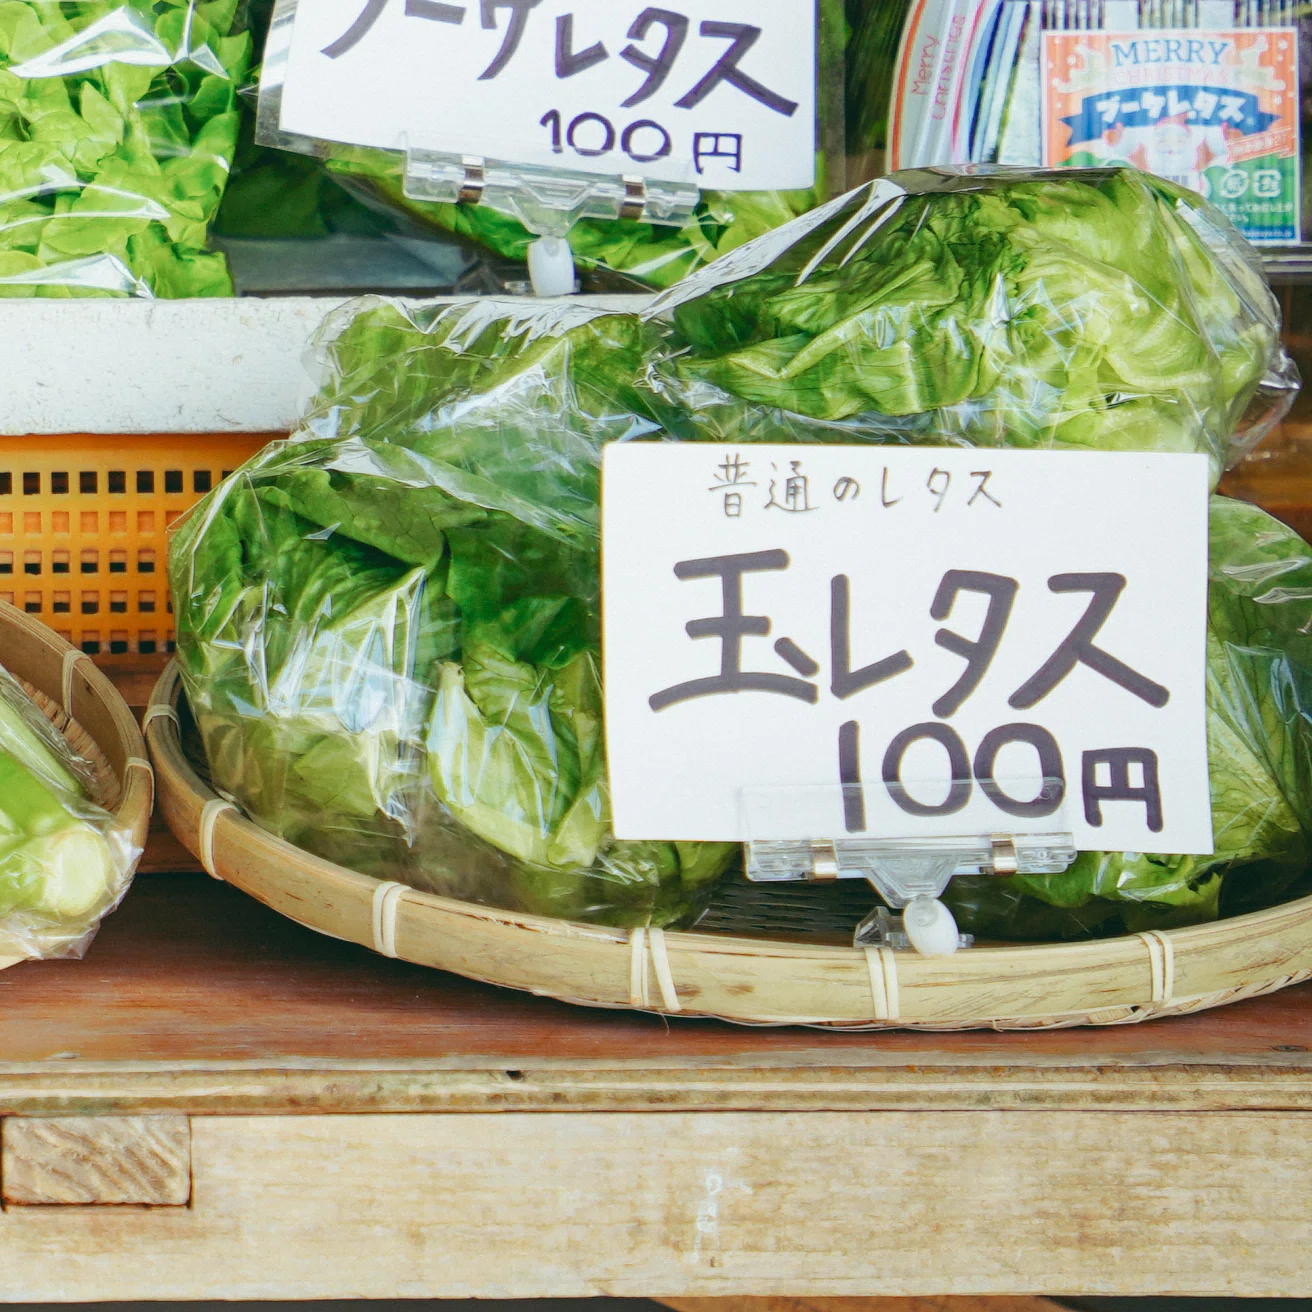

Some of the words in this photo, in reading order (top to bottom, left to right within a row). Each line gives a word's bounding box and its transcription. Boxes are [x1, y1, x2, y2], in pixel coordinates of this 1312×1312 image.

[912, 34, 940, 95] Merry
[1111, 40, 1228, 67] MERRY
[1115, 65, 1229, 85] CHRISTMAS
[539, 108, 744, 175] 100円
[708, 452, 1004, 519] 普通のレタス
[648, 548, 1171, 719] 玉レタス
[839, 719, 1164, 834] 100円
